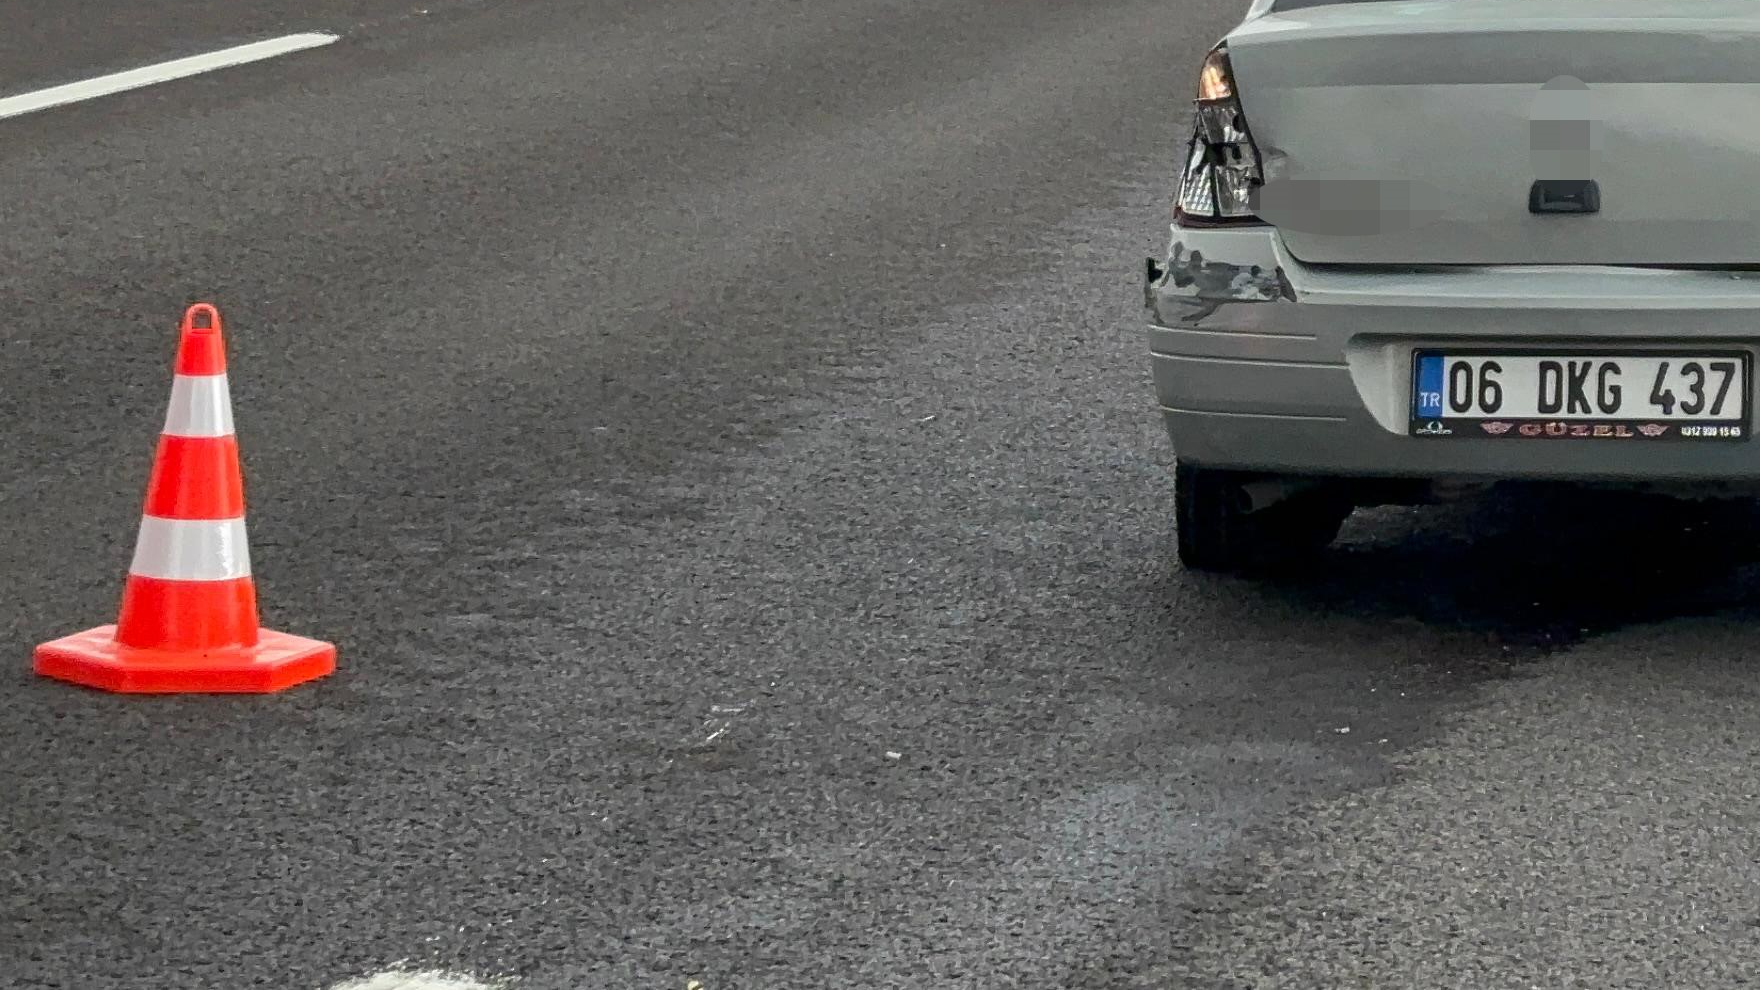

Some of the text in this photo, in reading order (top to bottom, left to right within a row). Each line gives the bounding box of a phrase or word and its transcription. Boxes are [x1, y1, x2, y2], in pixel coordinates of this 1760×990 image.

[1449, 360, 1736, 416] 06 DKG 437
[1420, 391, 1440, 408] TR
[1518, 421, 1634, 437] GÜZEL
